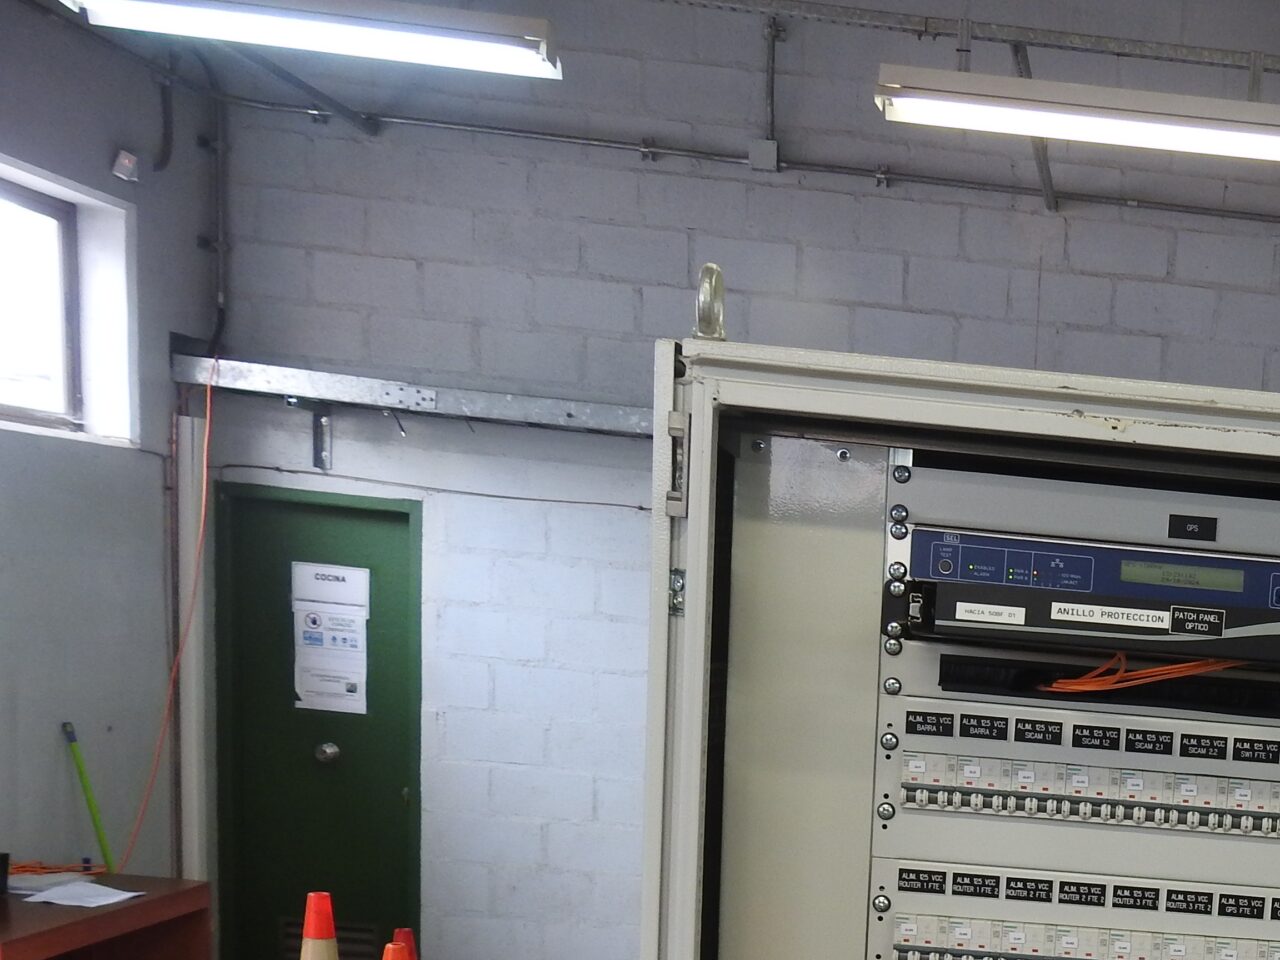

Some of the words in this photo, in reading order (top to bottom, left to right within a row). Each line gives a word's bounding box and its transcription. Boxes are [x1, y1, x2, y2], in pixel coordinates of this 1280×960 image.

[1186, 524, 1199, 532] GPS
[314, 572, 346, 583] COCINA
[1056, 607, 1095, 618] ANILLO
[1100, 610, 1164, 622] PROTECCION
[1174, 611, 1198, 621] PATCH
[1199, 613, 1220, 624] PANEL
[1185, 622, 1209, 632] OPTICO
[926, 716, 936, 724] 125
[916, 724, 936, 732] BARRA
[969, 727, 989, 736] BARRA
[1025, 732, 1043, 740] SICAM
[1081, 738, 1100, 746] SICAM
[1135, 742, 1153, 750] SICAM
[1188, 747, 1206, 755] SICAM
[899, 880, 921, 889] ROUTER
[953, 885, 974, 893] ROUTER
[1006, 889, 1027, 897] ROUTER
[1059, 893, 1079, 901] ROUTER
[1113, 897, 1134, 905] ROUTER
[1167, 901, 1186, 909] ROUTER
